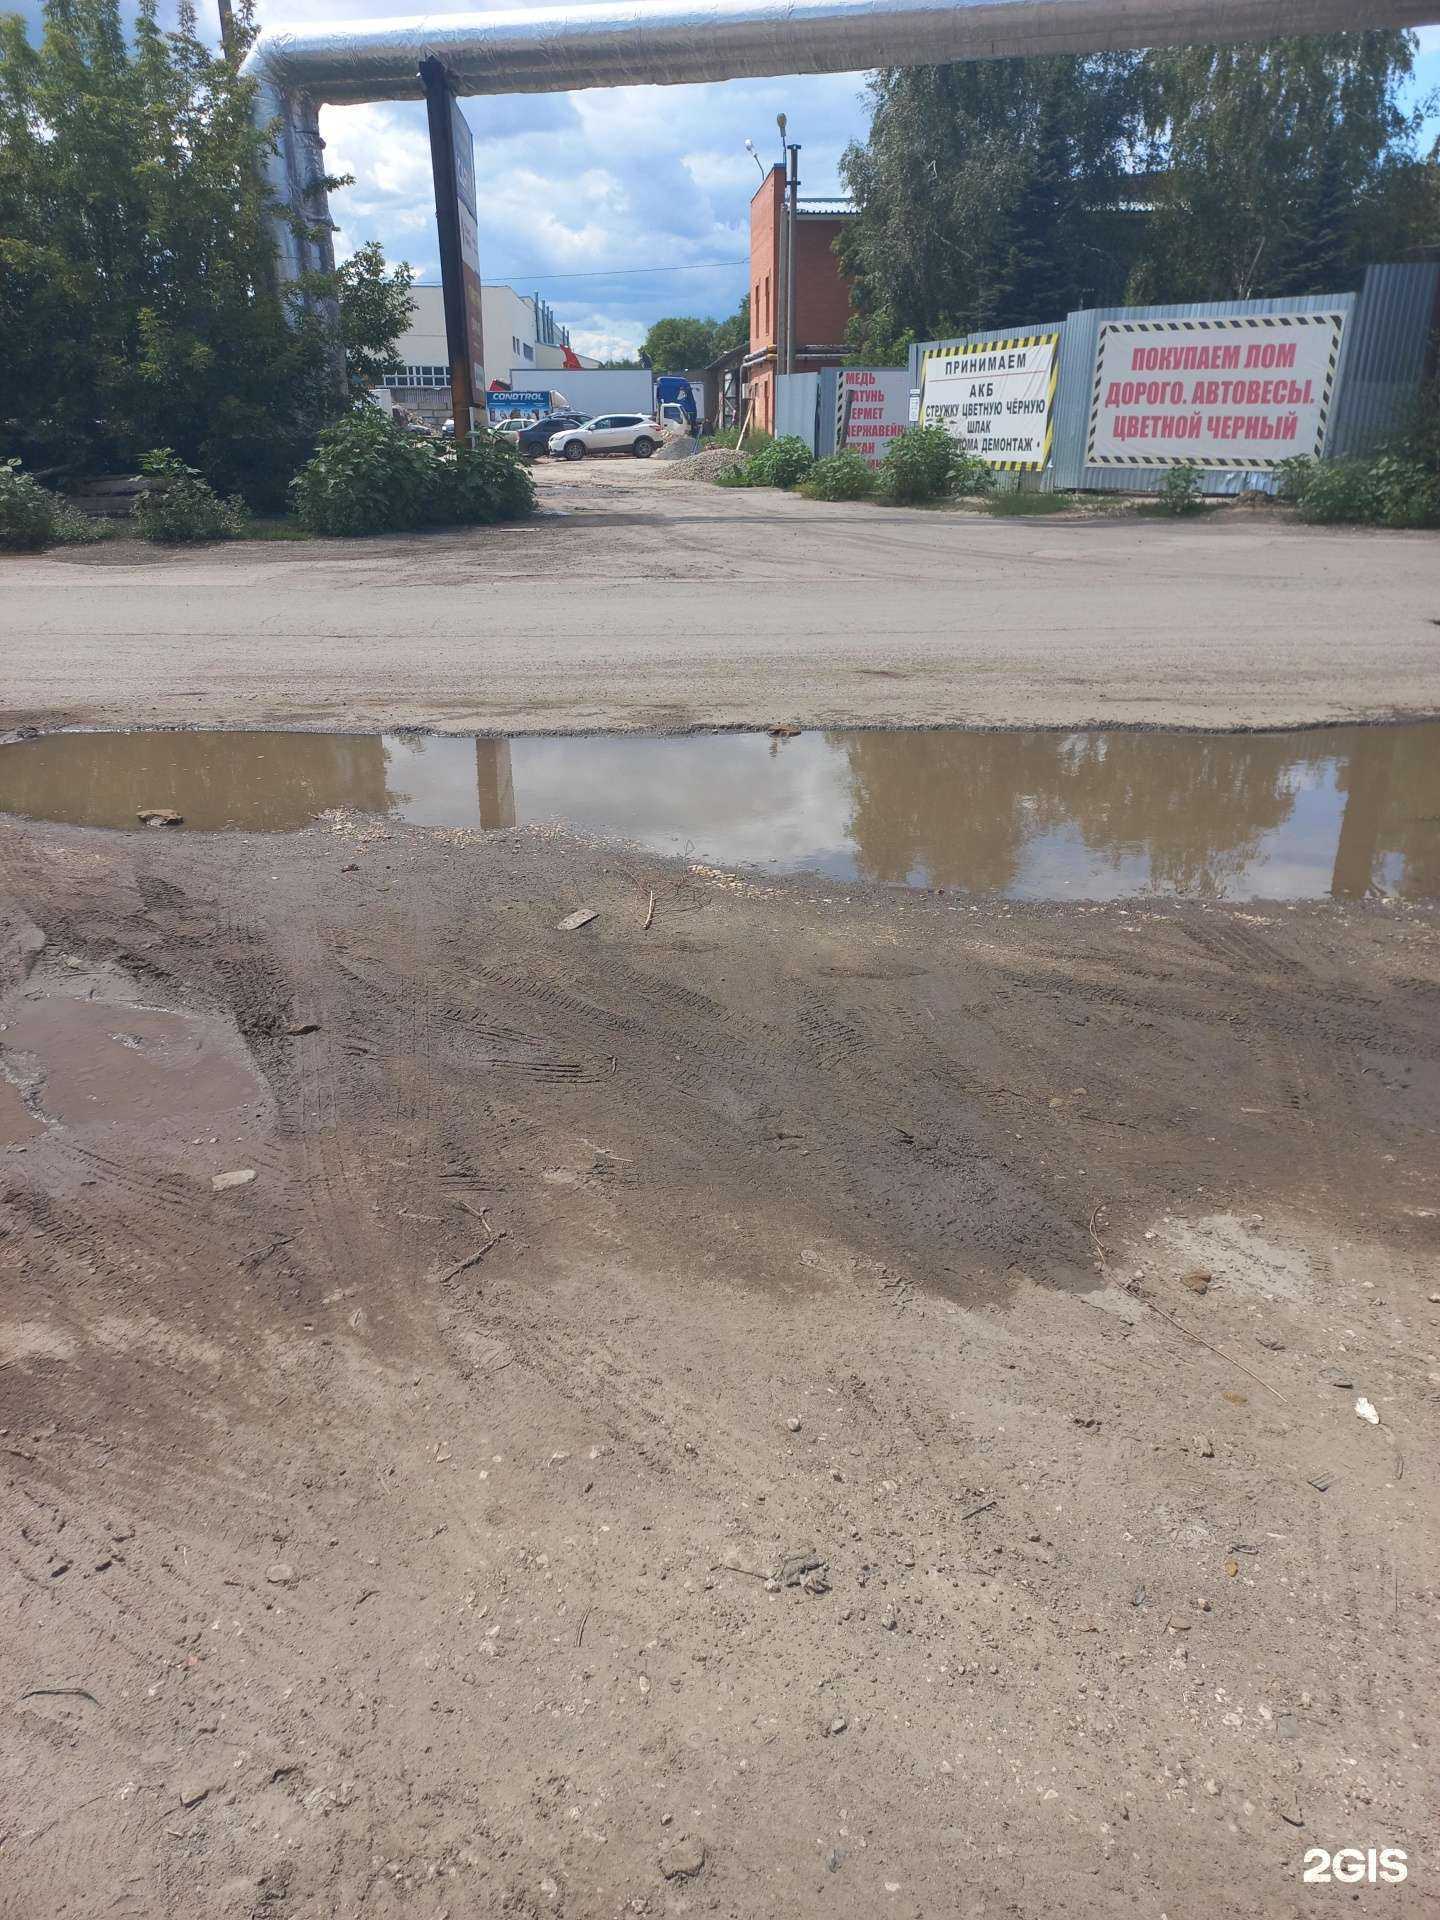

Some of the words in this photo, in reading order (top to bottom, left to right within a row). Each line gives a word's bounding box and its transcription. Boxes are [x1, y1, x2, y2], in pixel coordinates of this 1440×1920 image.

[945, 353, 1027, 375] ПРИНИМАЕМ
[1131, 344, 1242, 371] ПОКУПАЕМ
[1244, 343, 1297, 368] ЛОМ
[846, 373, 876, 386] МЕДЬ
[493, 392, 543, 401] CONDTROL
[847, 390, 885, 402] АТУНЬ
[969, 383, 994, 398] АКБ
[1105, 380, 1187, 408] ДОРОГО.
[1191, 379, 1314, 405] АВТОВЕСЫ.
[851, 408, 884, 420] ЕРМЕТ
[926, 404, 959, 418] СТРУЖКУ
[962, 401, 1003, 419] ЦВЕТНУЮ
[967, 420, 991, 434] ШЛАК
[1113, 411, 1202, 442] ЦВЕТНОЙ
[1207, 411, 1299, 440] ЧЕРНЫЙ
[981, 438, 1034, 453] ДЕМОНТАЖ
